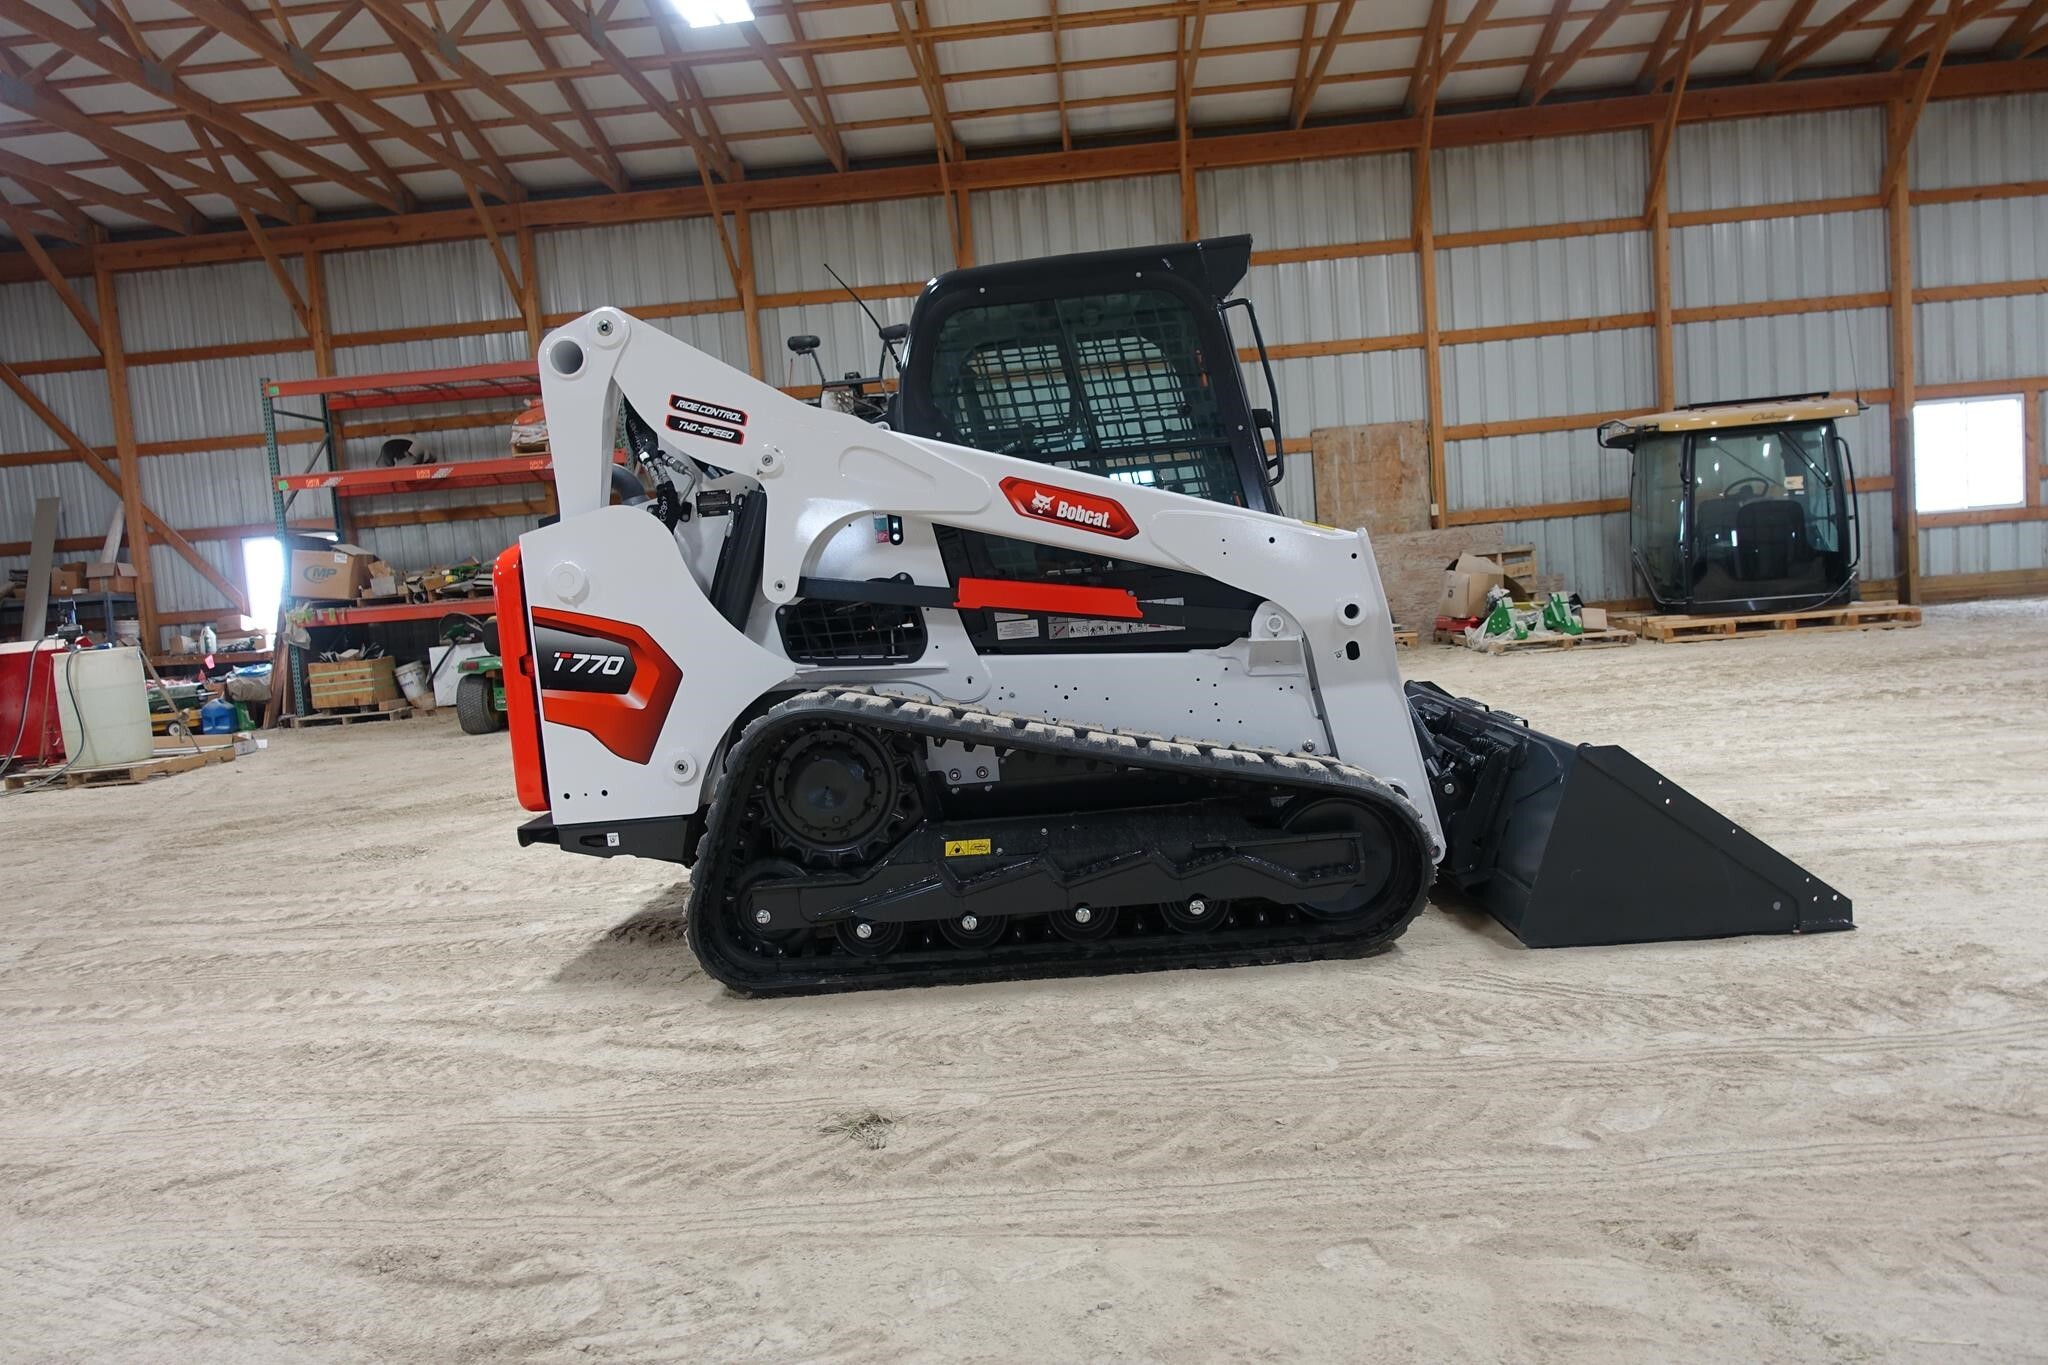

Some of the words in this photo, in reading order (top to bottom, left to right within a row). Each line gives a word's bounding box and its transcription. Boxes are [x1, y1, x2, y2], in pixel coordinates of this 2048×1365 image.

[676, 399, 700, 412] RIDE
[698, 405, 742, 422] CONTROL
[678, 420, 735, 440] TWO-SPEED
[1056, 500, 1110, 528] Bobcat
[553, 651, 625, 676] T770
